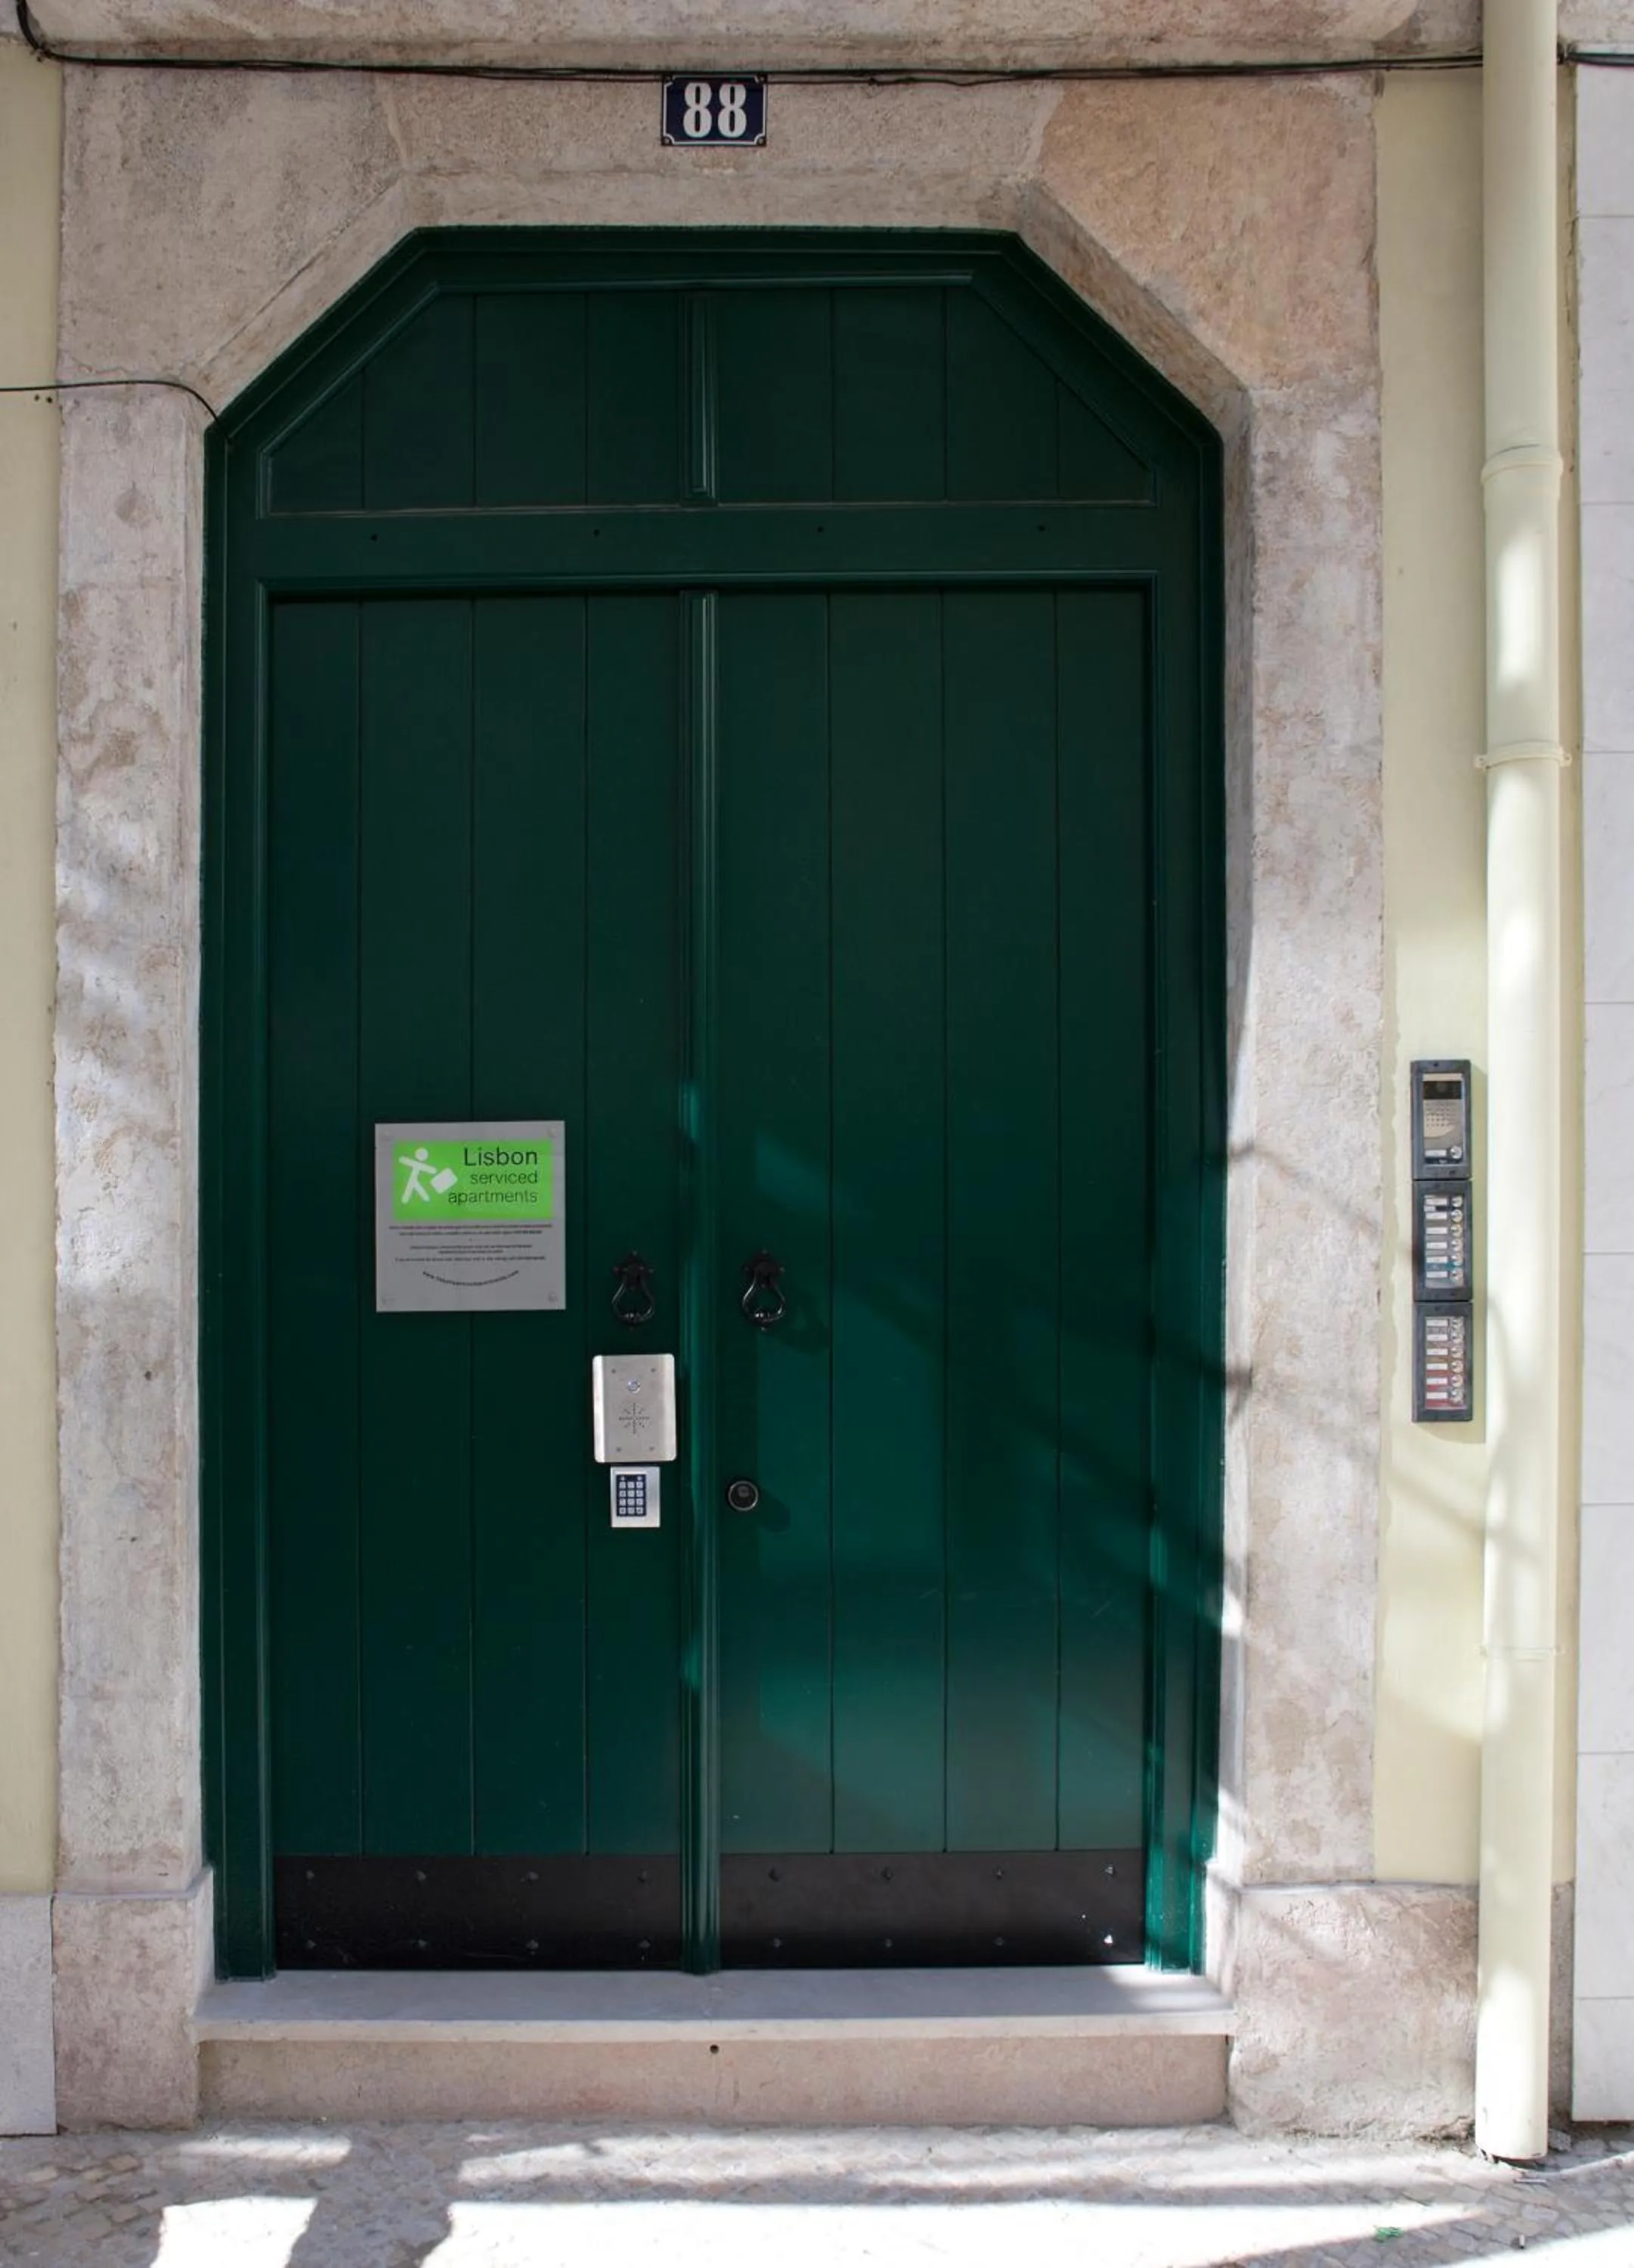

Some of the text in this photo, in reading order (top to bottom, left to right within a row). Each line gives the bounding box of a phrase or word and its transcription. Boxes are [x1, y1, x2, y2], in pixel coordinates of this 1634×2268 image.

[682, 82, 747, 138] 88
[464, 1146, 537, 1167] Lisbon
[470, 1170, 538, 1185] serviced
[448, 1189, 538, 1206] apartments
